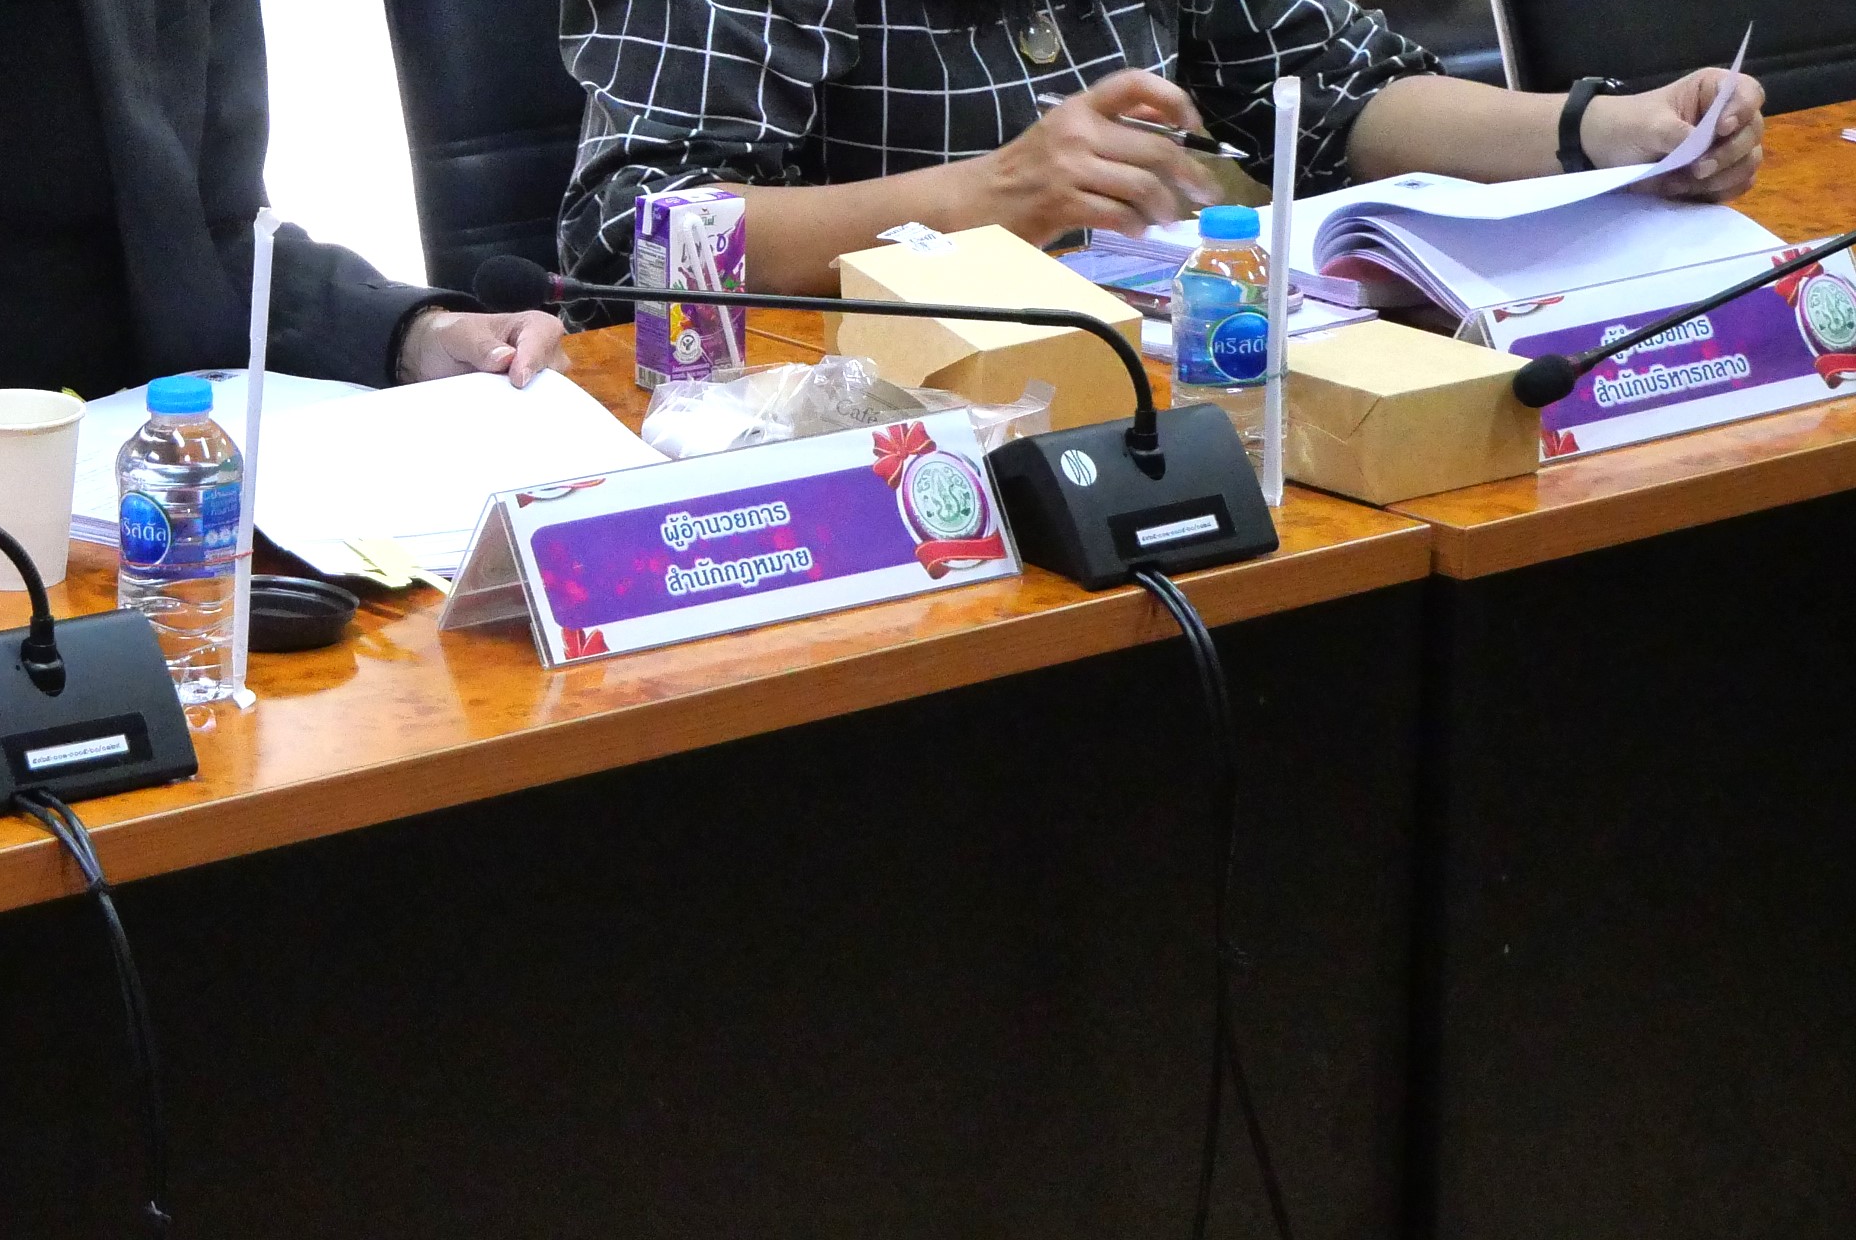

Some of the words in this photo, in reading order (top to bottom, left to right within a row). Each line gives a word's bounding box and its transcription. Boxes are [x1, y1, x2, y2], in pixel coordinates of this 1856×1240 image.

[1213, 334, 1268, 355] คริสตั
[1604, 317, 1711, 360] ู้ำนวยการ
[1596, 356, 1748, 404] สำนักบริหารกลาง
[120, 516, 167, 542] ริสตัล
[663, 504, 788, 548] ผู้อำนวยการ
[667, 549, 810, 593] สำนักกฎหมาย
